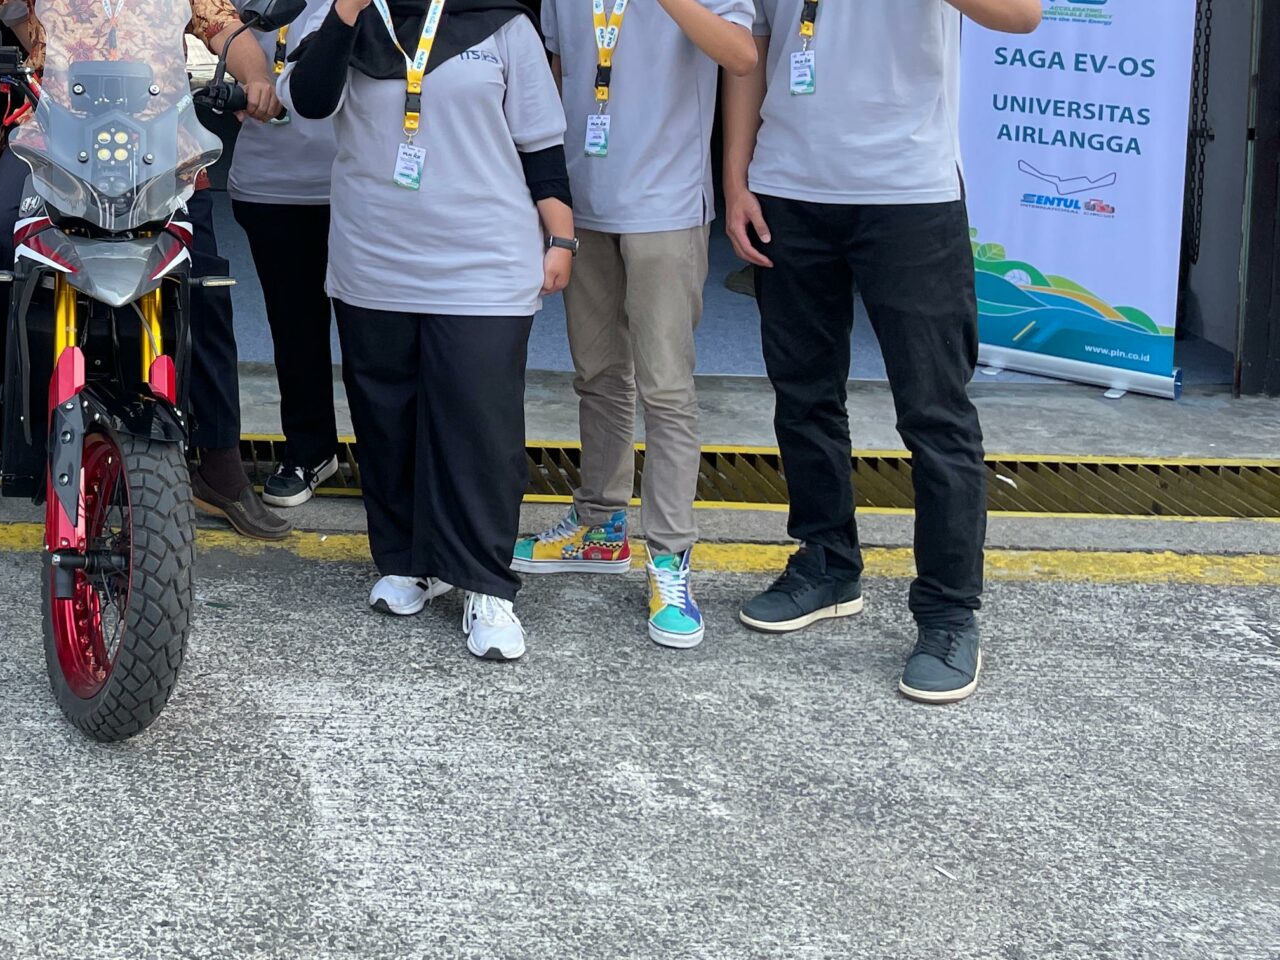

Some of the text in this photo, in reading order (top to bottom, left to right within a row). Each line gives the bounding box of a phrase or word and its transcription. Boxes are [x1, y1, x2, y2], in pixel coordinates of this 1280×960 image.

[460, 50, 481, 61] ITS
[994, 47, 1156, 78] SAGA EV-OS
[992, 94, 1151, 126] UNIVERSITAS
[996, 123, 1142, 156] AIRLANGGA
[1021, 193, 1082, 210] SENTUL
[1084, 344, 1150, 362] www.pln.co.id
